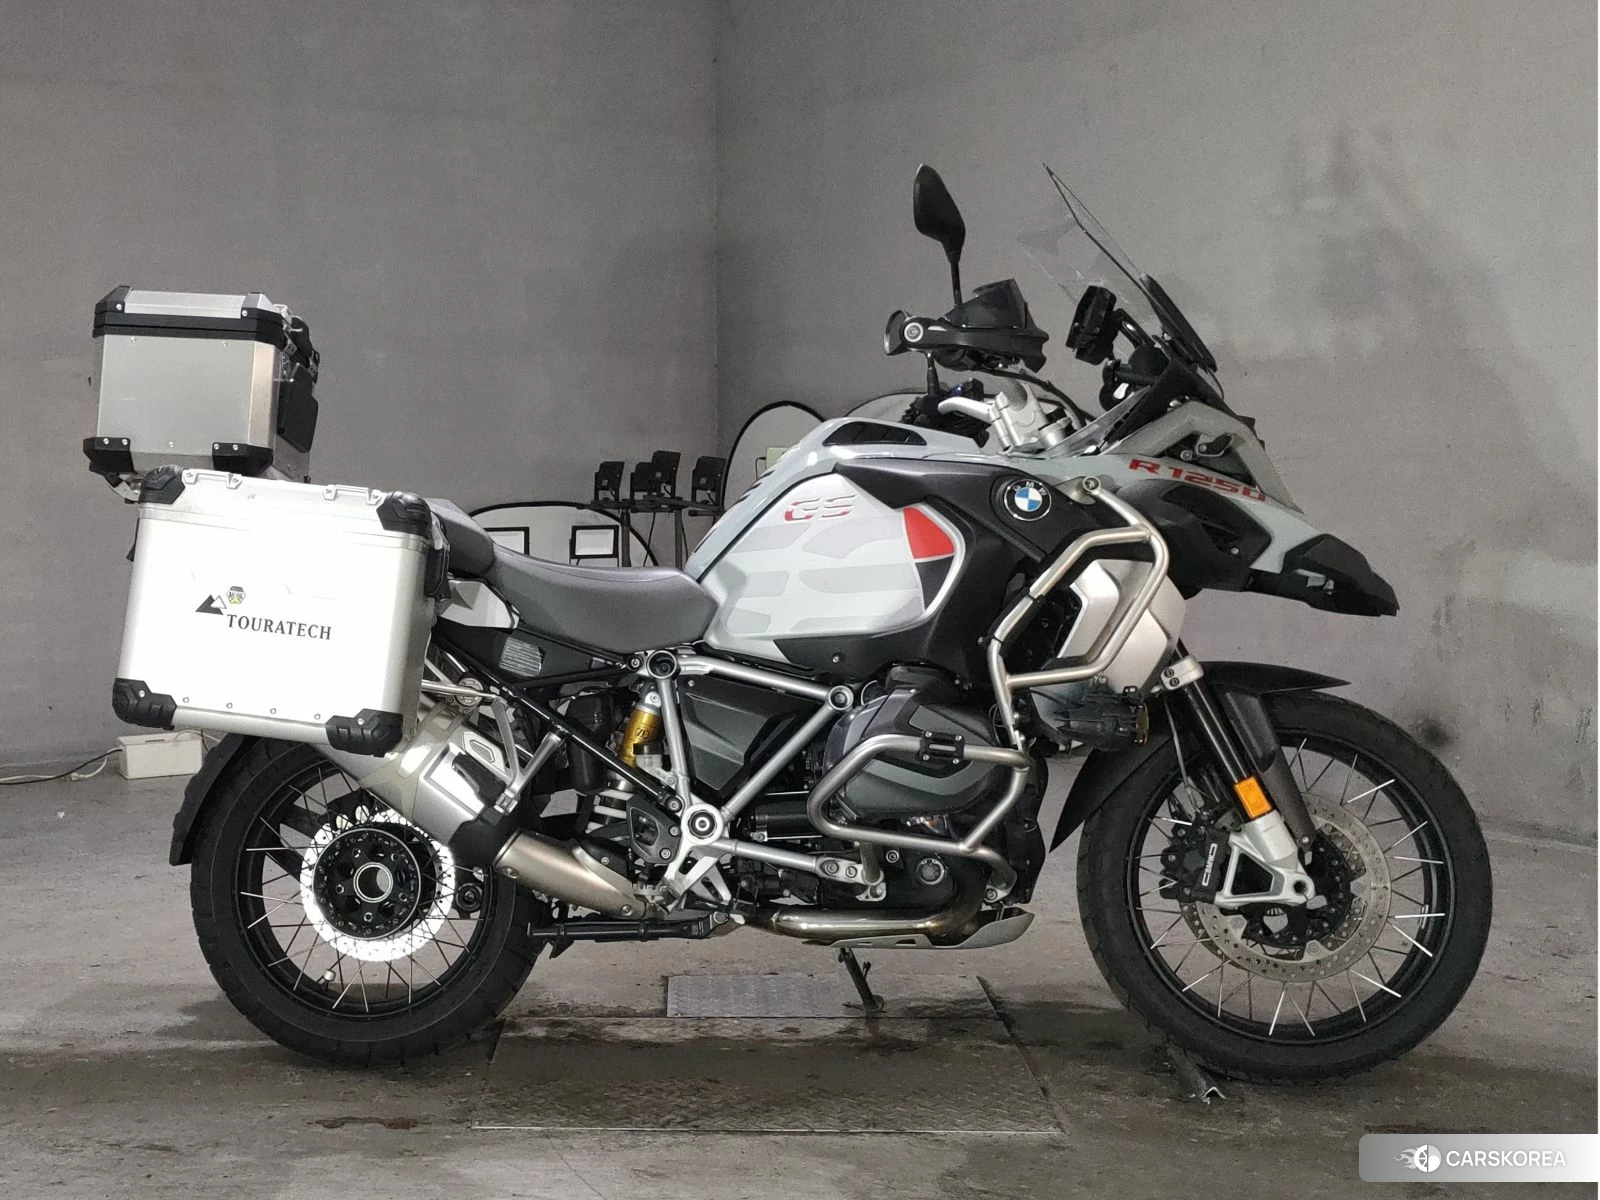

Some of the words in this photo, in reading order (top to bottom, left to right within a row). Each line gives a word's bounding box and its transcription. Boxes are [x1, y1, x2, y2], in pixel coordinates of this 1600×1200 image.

[1128, 459, 1161, 475] R
[1167, 466, 1266, 502] 1250
[784, 494, 857, 521] GS
[226, 613, 333, 640] TOURATECH
